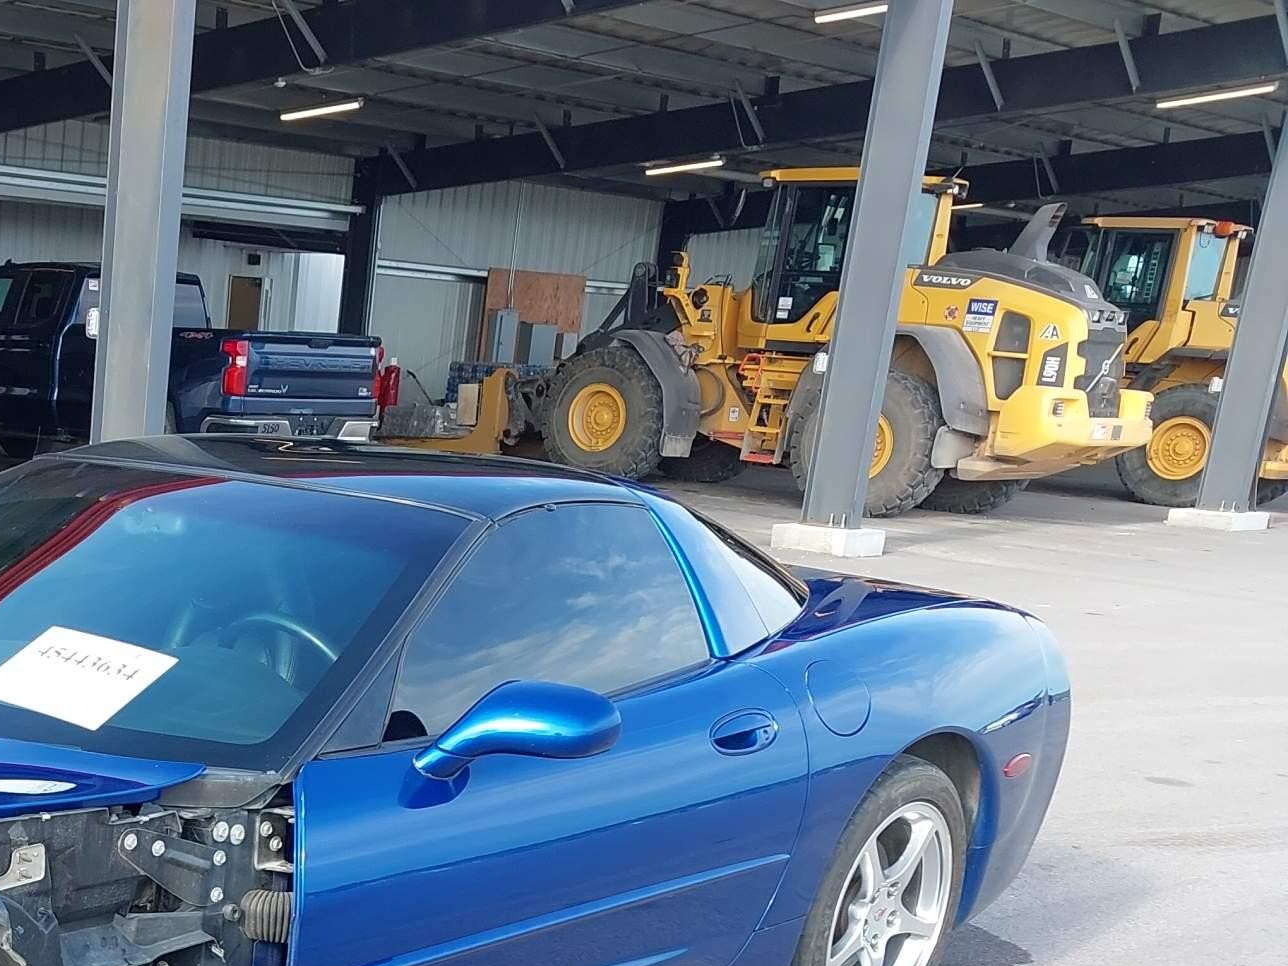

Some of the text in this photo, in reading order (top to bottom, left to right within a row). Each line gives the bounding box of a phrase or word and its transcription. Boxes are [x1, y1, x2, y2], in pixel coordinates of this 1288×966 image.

[921, 274, 972, 287] VOLVO
[970, 301, 995, 314] WISE
[1041, 356, 1061, 383] L90H
